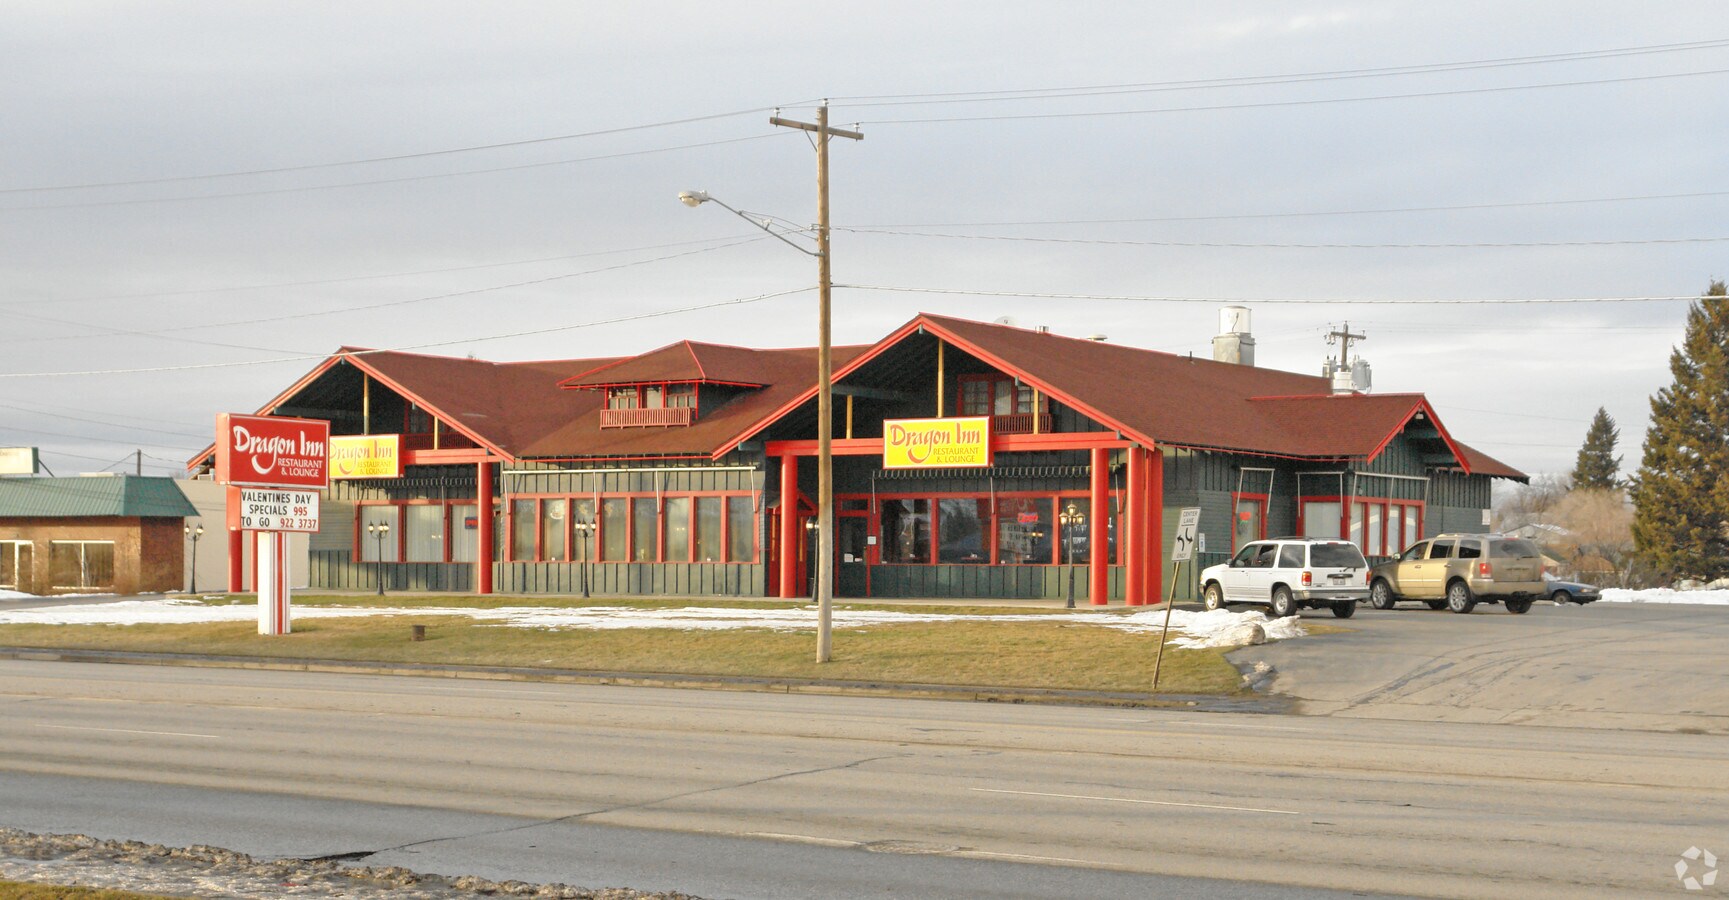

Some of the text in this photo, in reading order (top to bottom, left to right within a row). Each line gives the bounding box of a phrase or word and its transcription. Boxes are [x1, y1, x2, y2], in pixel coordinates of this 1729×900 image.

[374, 439, 392, 458] Inn
[890, 422, 980, 464] Dragon Inn
[233, 425, 324, 475] Dragon Inn
[933, 447, 979, 455] RESTAURANT
[277, 457, 323, 469] RESTAURANT
[936, 455, 976, 463] & LOUNGE
[281, 467, 319, 477] & LOUNGE
[241, 491, 312, 504] VALENTINES DAY
[249, 504, 308, 516] SPECIALS 995
[241, 516, 317, 529] TO GO 922 3737
